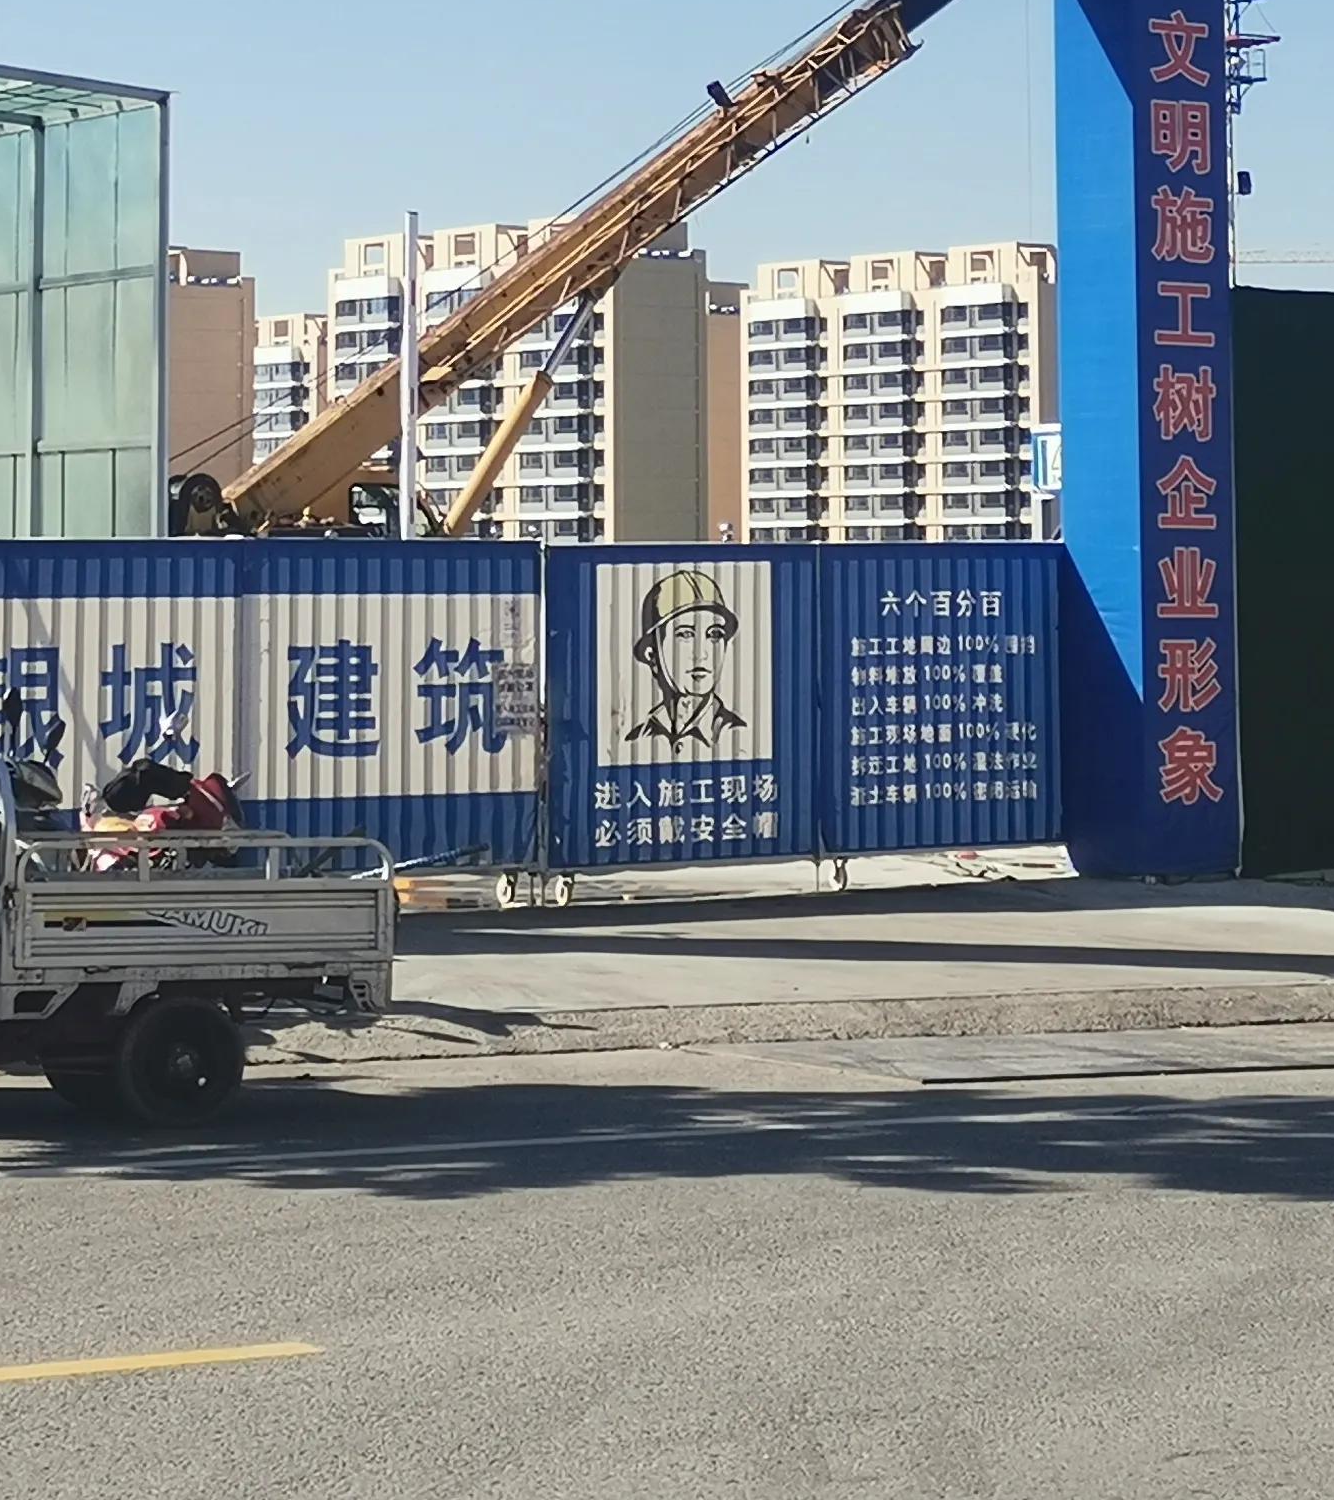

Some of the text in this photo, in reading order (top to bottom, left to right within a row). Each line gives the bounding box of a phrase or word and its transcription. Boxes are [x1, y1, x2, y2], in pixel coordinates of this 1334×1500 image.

[1148, 9, 1223, 807] 文明施工树企业形象
[880, 588, 1002, 618] 六个百分百
[958, 634, 999, 654] 100%
[924, 664, 967, 684] 100%
[851, 692, 1004, 716] 出入车辆 100% 冲洗
[851, 721, 1037, 746] 施工现场地面 100% 硬化
[924, 752, 967, 772] 100%
[594, 773, 779, 811] 进入施工现场
[924, 781, 967, 801] 100%
[594, 811, 779, 848] 必须戴安全帽
